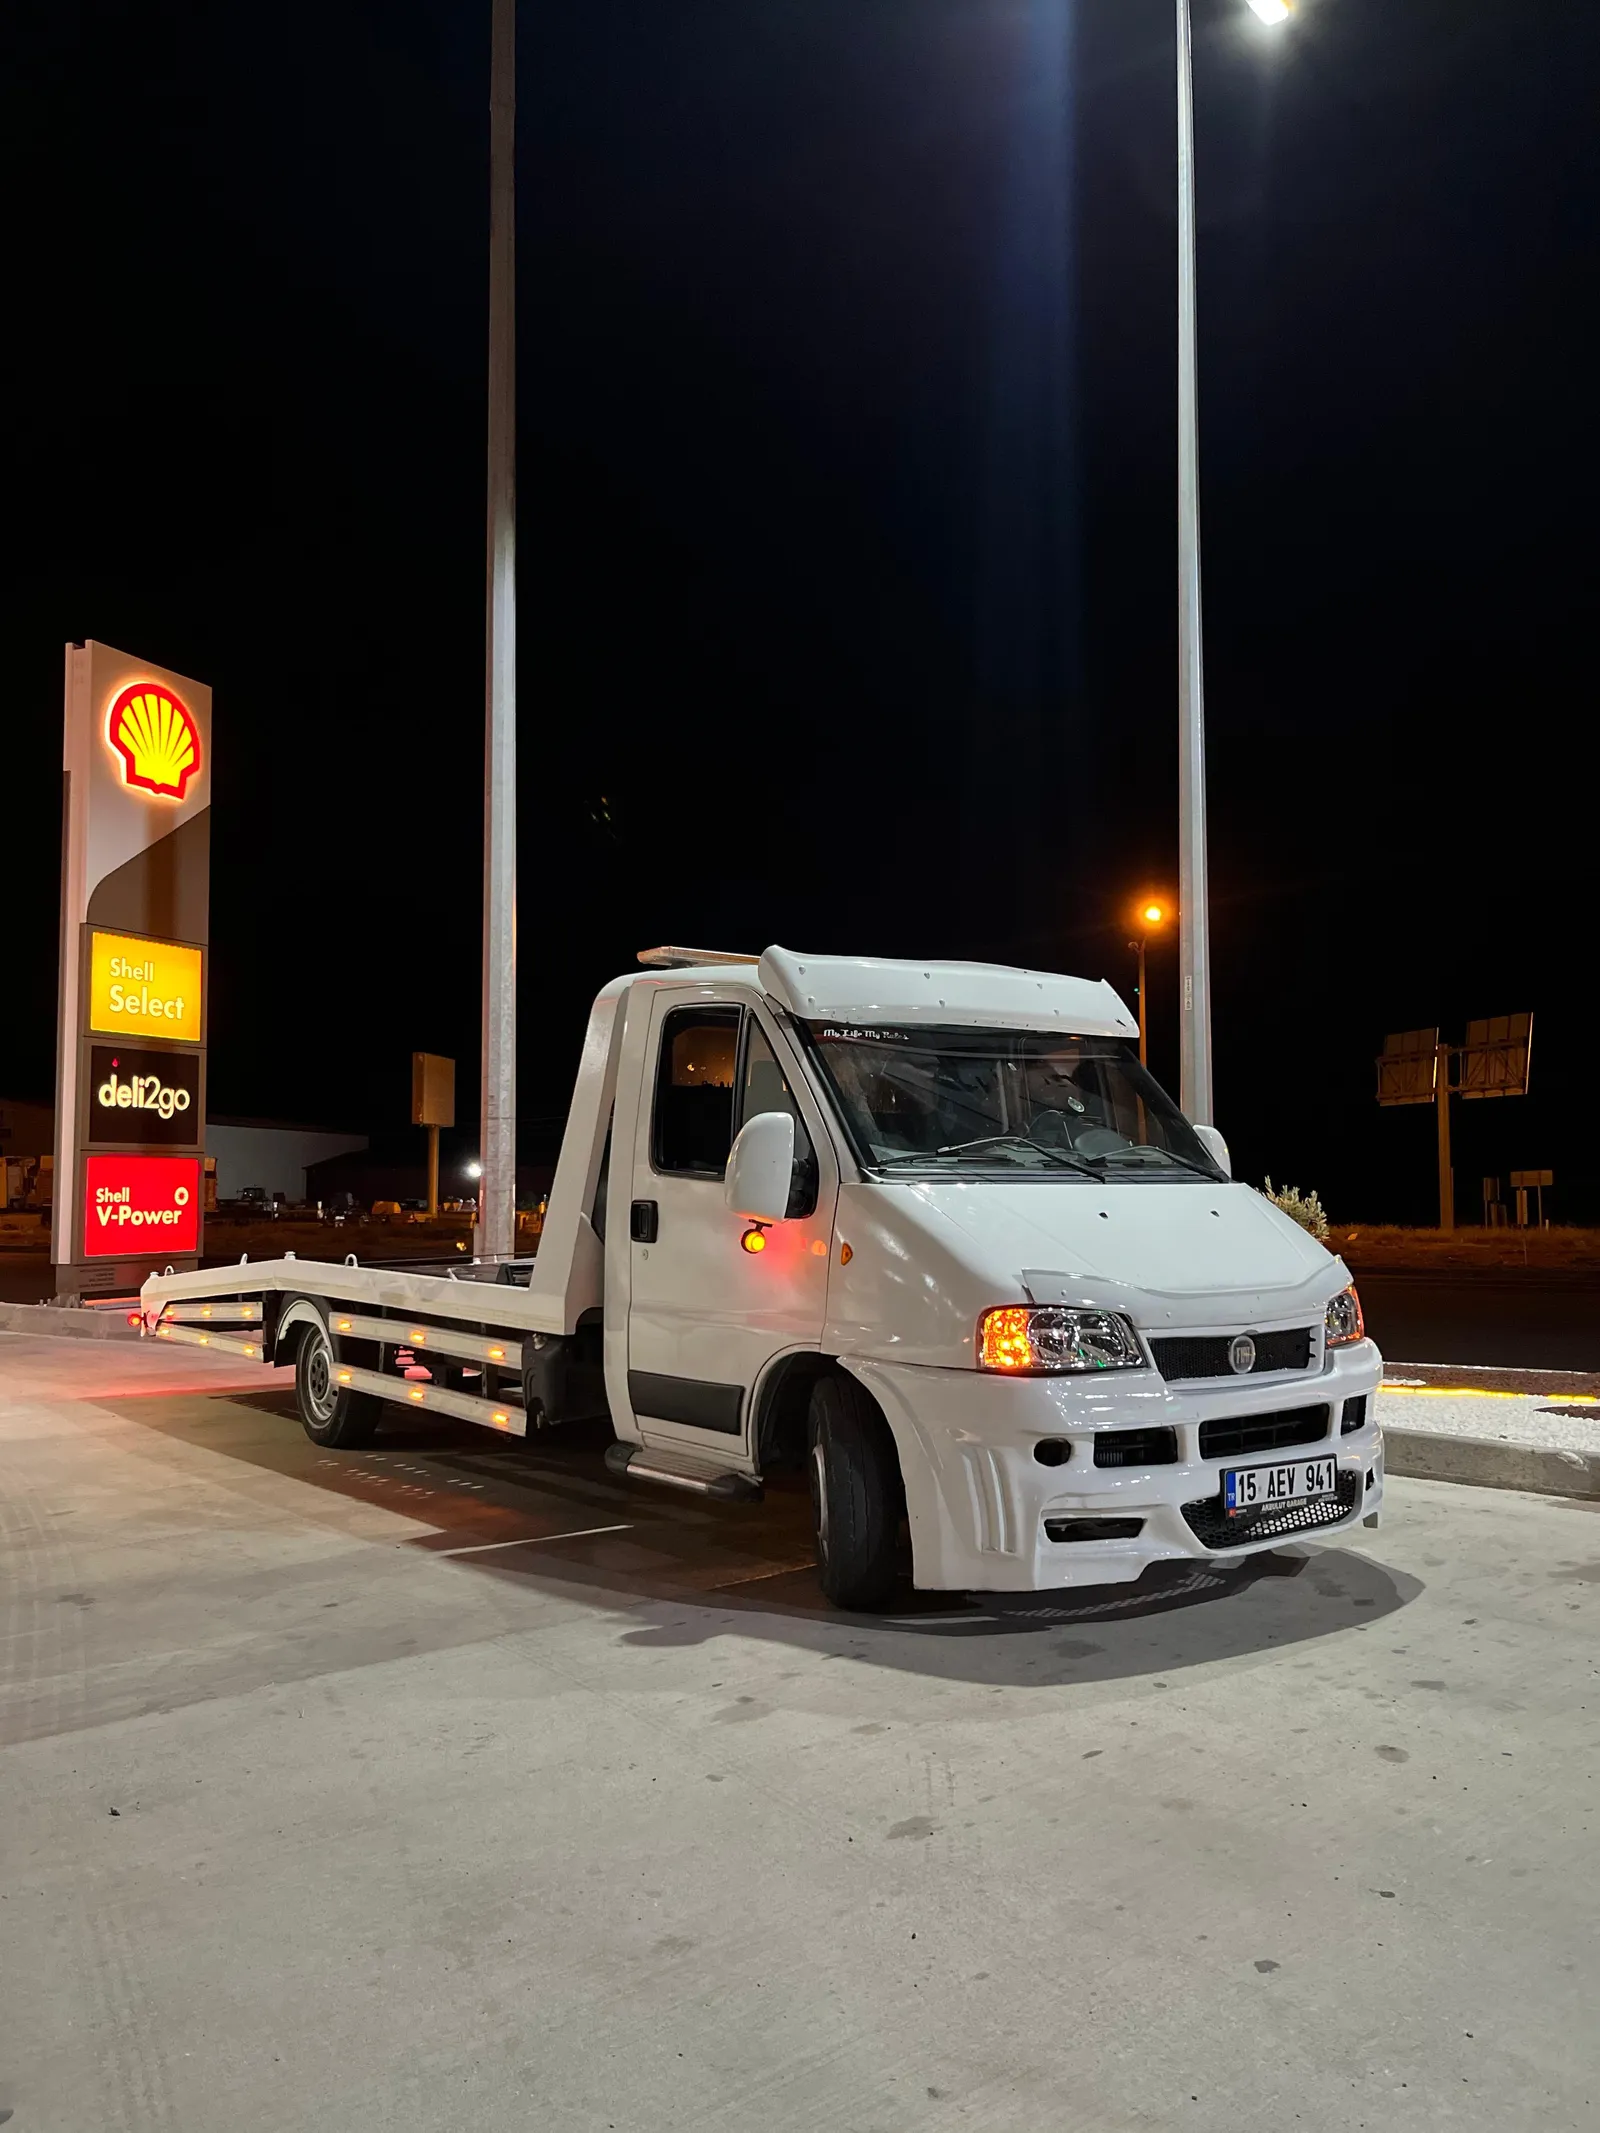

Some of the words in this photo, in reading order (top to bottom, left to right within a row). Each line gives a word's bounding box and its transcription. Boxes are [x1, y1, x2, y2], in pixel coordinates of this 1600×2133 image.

[109, 957, 154, 982] Shell
[109, 984, 185, 1020] Select
[823, 1029, 840, 1038] My
[864, 1030, 881, 1039] My
[99, 1074, 190, 1120] deli2go
[96, 1187, 130, 1203] Shell
[96, 1205, 182, 1226] V-Power
[1239, 1473, 1256, 1502] 15
[1267, 1467, 1295, 1499] AEV
[1306, 1462, 1332, 1492] 941
[1227, 1492, 1236, 1501] TR
[1286, 1498, 1307, 1508] GARAGE
